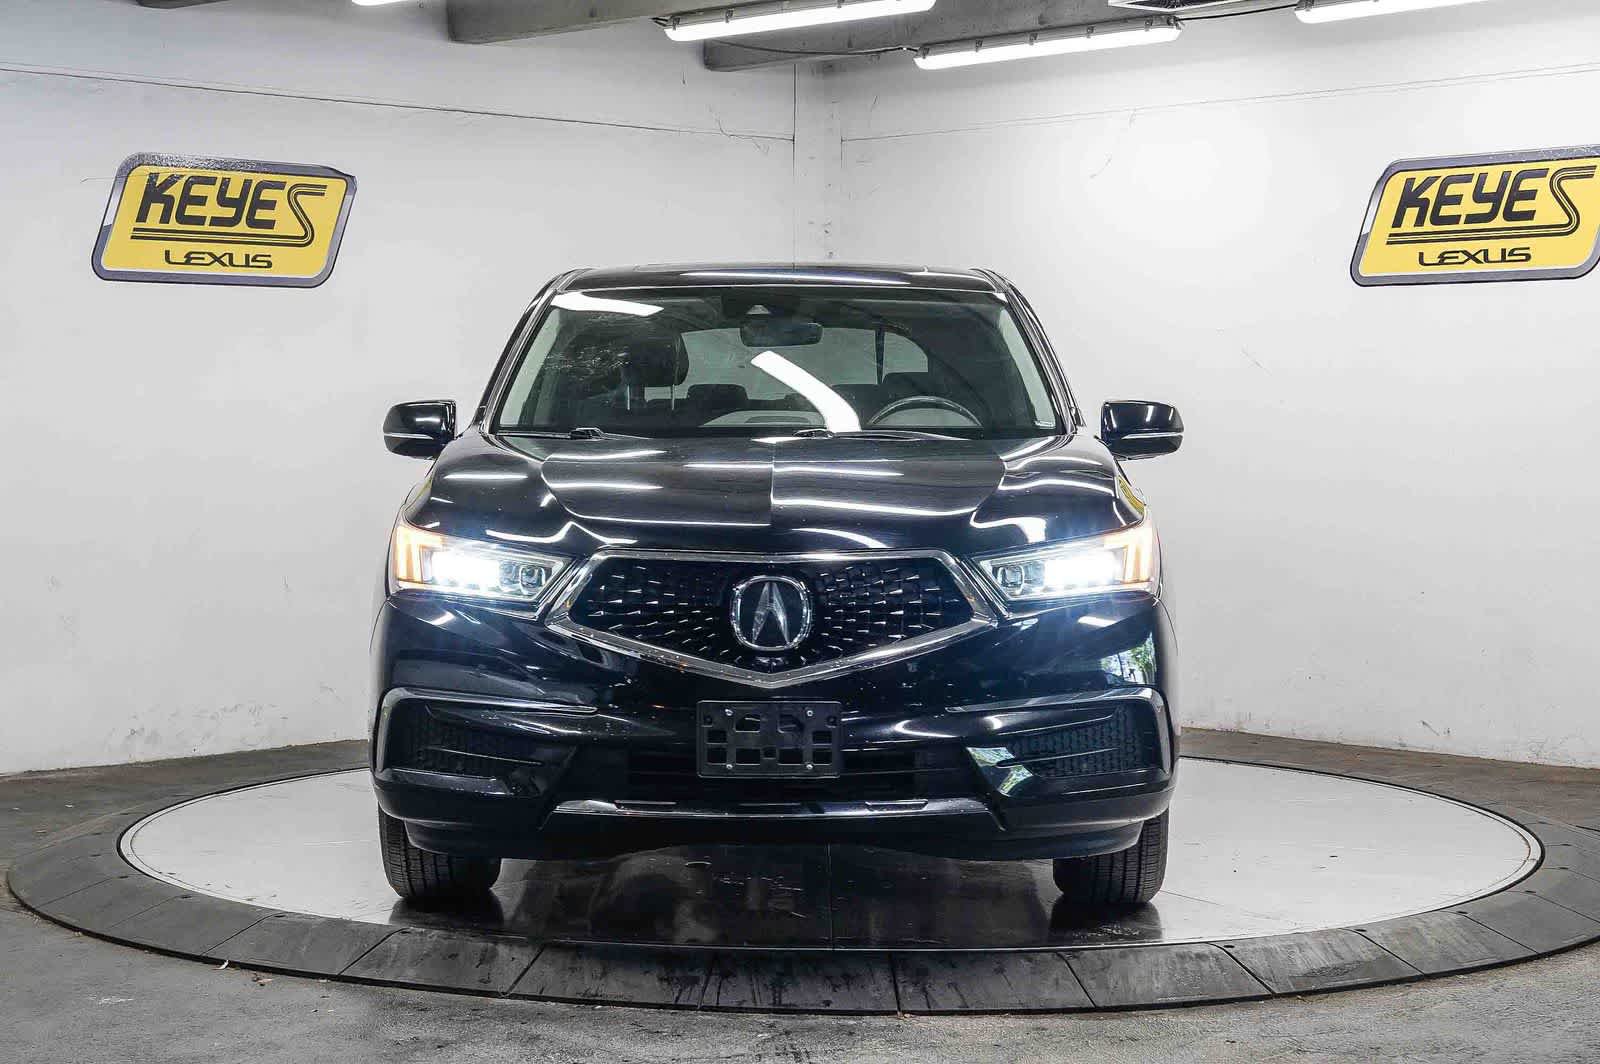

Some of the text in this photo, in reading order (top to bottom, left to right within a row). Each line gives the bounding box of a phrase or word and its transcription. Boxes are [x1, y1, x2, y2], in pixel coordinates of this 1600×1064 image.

[131, 172, 327, 247] KEYES
[1387, 165, 1597, 245] KEYES
[164, 250, 273, 269] LEXUS
[1418, 247, 1532, 266] LEXUS
